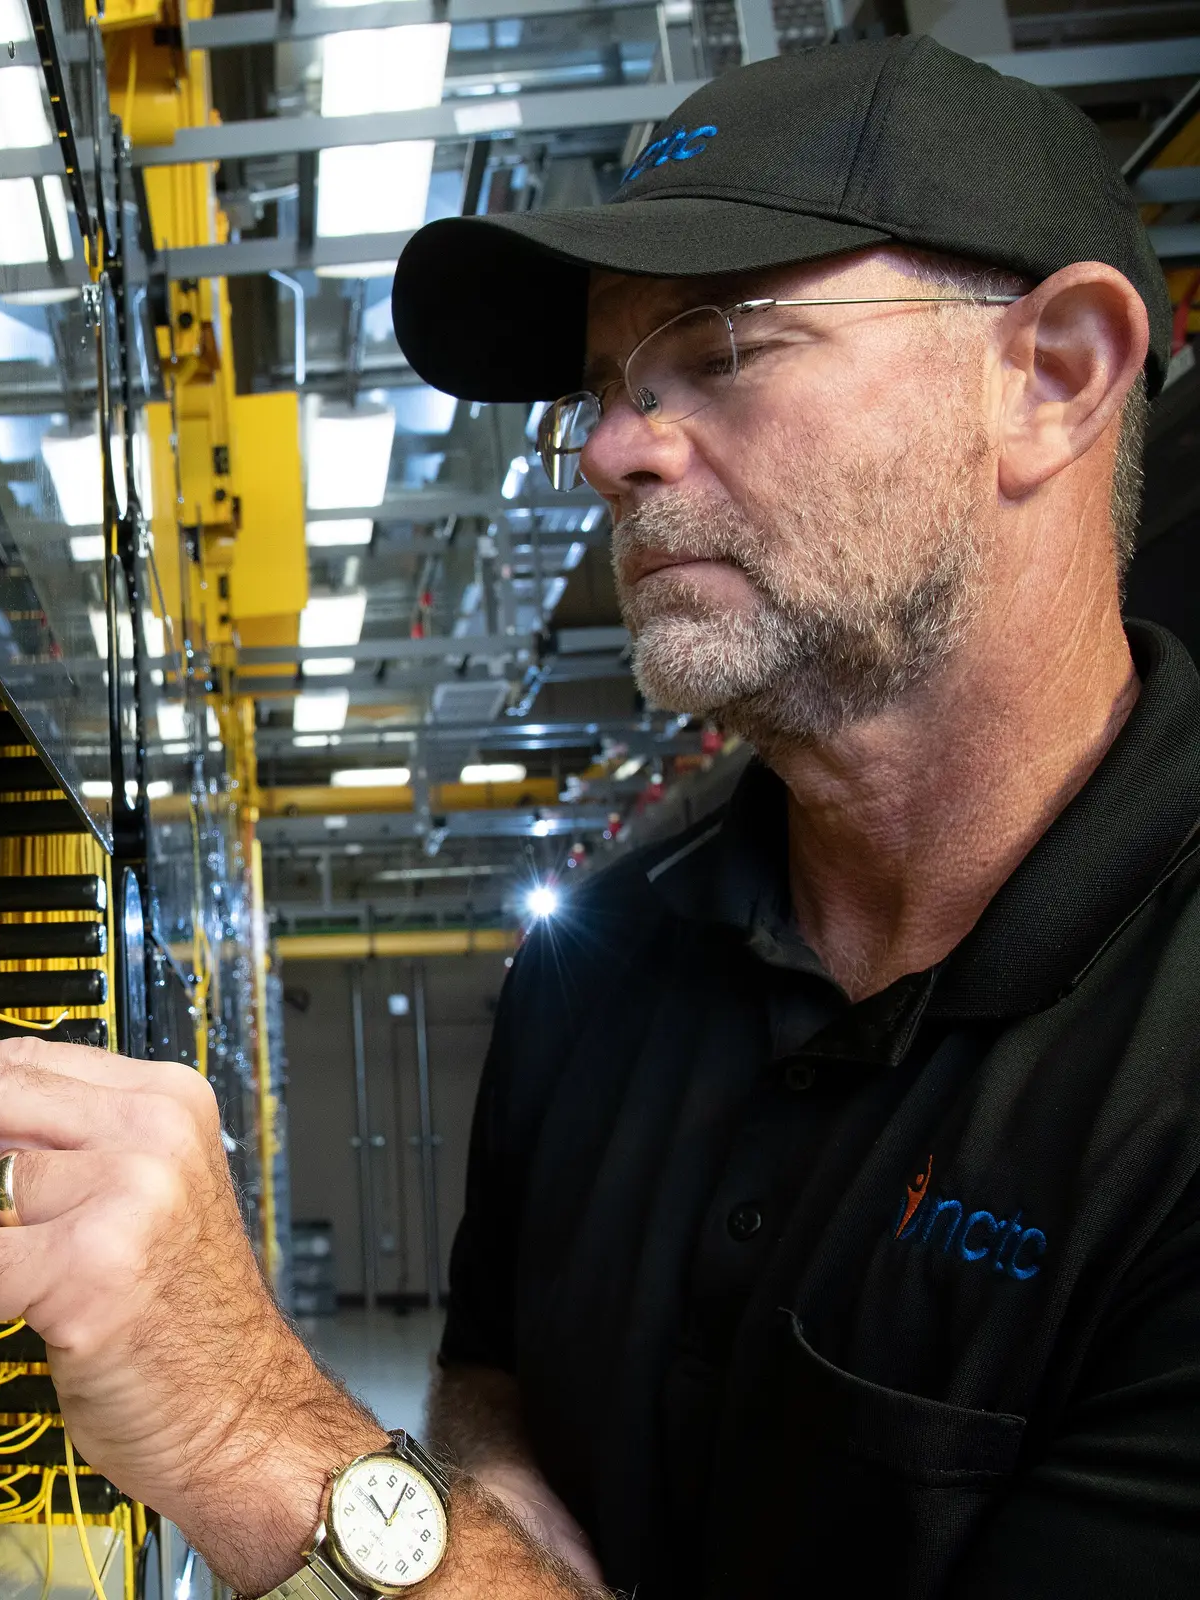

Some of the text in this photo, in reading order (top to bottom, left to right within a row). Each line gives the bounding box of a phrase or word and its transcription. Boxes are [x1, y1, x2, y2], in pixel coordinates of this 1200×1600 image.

[621, 125, 718, 184] ctc
[921, 1196, 1047, 1281] nctc
[367, 1475, 378, 1487] 4
[386, 1474, 398, 1488] 5
[405, 1487, 416, 1500] 6
[343, 1502, 356, 1517] 2
[417, 1509, 428, 1520] 7
[420, 1529, 431, 1542] 8
[356, 1544, 369, 1561] 12
[412, 1548, 424, 1562] 9
[376, 1560, 388, 1574] 11
[395, 1559, 409, 1575] 10
